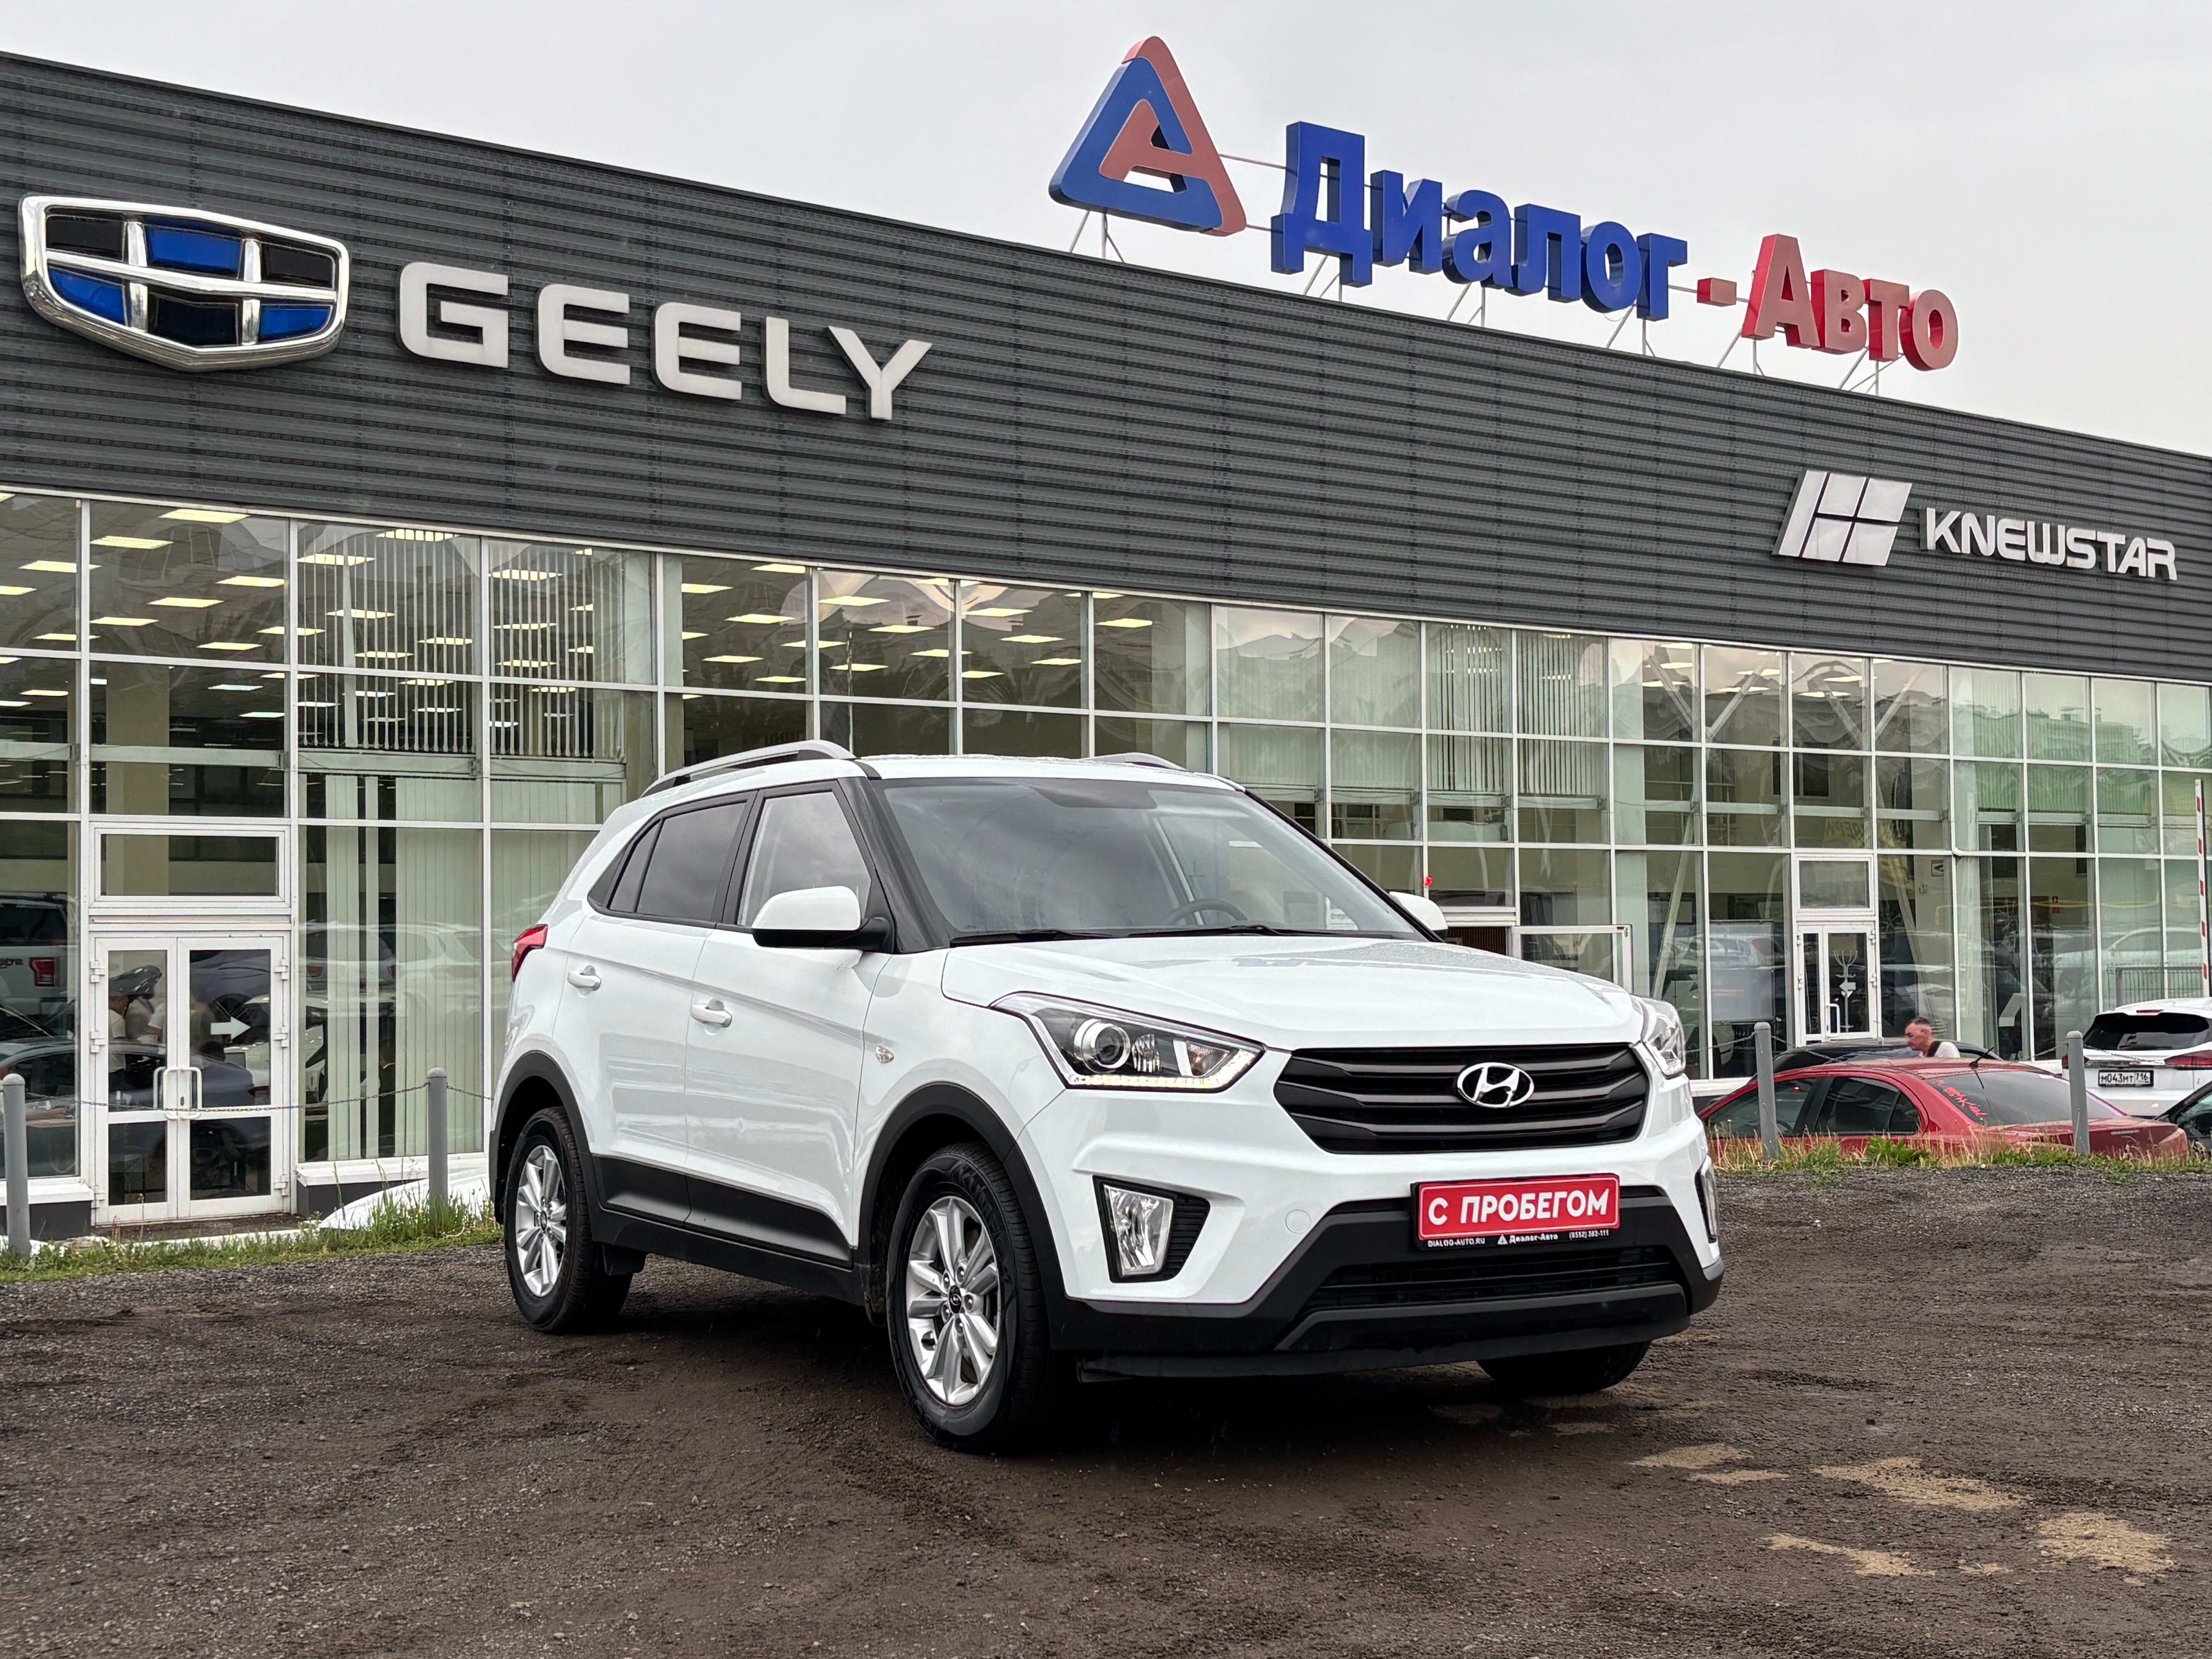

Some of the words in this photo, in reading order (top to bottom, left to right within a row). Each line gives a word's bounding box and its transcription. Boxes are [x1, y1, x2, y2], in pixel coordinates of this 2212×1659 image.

[397, 261, 933, 420] GEELY
[1924, 507, 2178, 580] KNEWSTAR
[1428, 1197, 1448, 1226] С
[1460, 1188, 1609, 1224] ПРОБЕГОМ
[1428, 1238, 1485, 1247] DIALOG-AUTO.RU
[1509, 1233, 1559, 1244] Диалог-Авто
